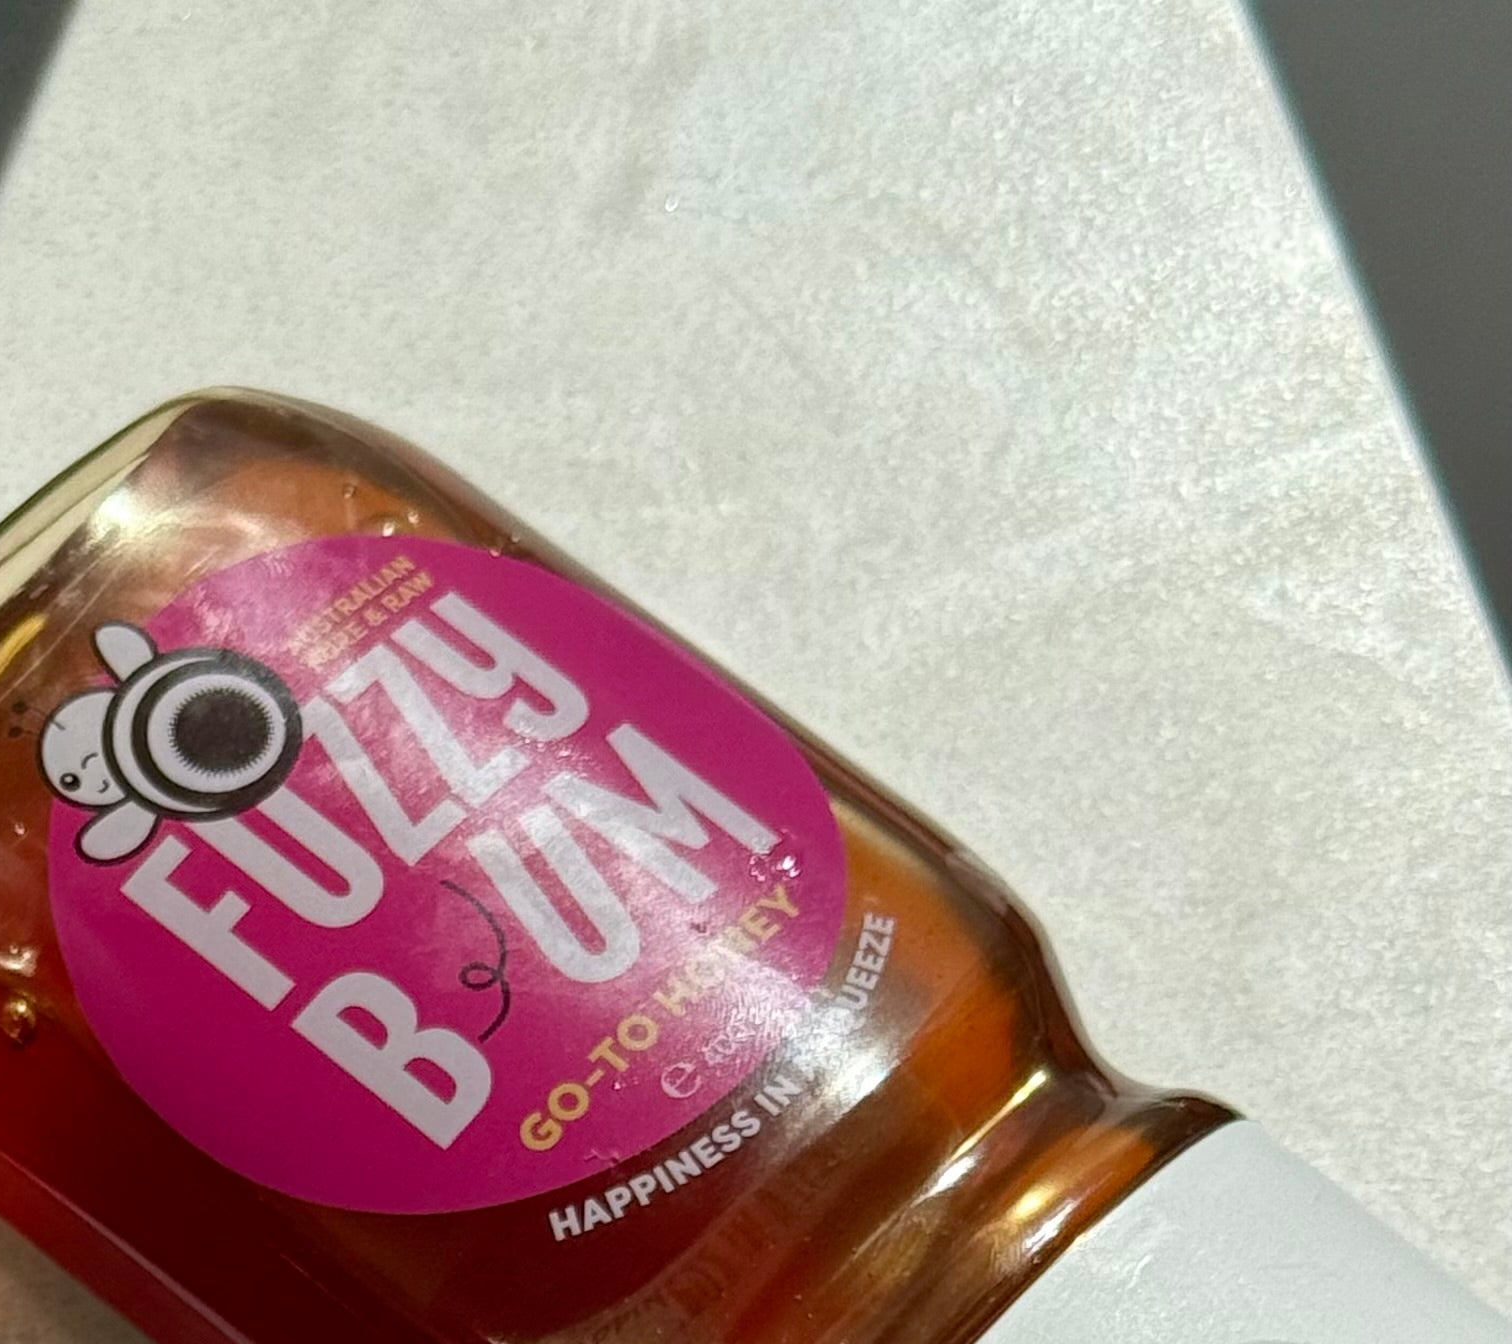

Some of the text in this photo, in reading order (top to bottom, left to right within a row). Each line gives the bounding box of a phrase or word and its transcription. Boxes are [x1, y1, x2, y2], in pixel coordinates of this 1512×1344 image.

[380, 570, 434, 614] RAW
[119, 590, 591, 1013] FUZZY
[519, 1014, 659, 1152] GO-TO
[652, 885, 800, 1017] HONEY
[548, 1110, 762, 1242] HAPPINESS
[754, 1075, 802, 1117] IN
[802, 912, 896, 1057] UEEZE
